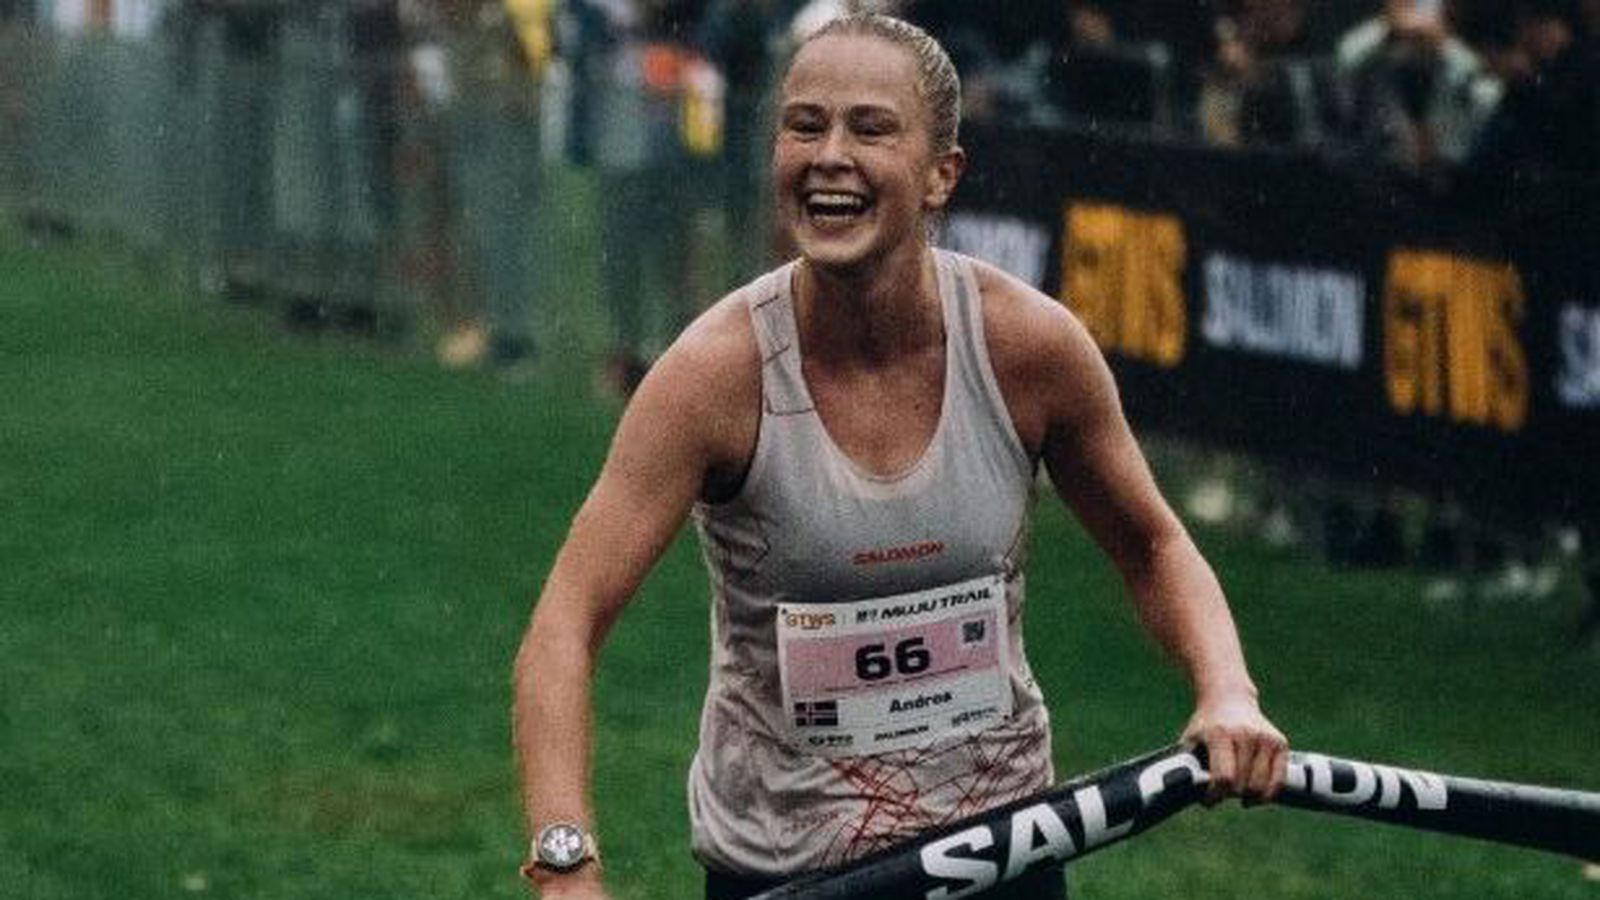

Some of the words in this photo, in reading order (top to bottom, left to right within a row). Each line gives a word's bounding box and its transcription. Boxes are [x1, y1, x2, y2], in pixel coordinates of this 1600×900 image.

[853, 541, 944, 565] SALOMON
[939, 587, 992, 609] TRAIL
[855, 637, 931, 681] 66
